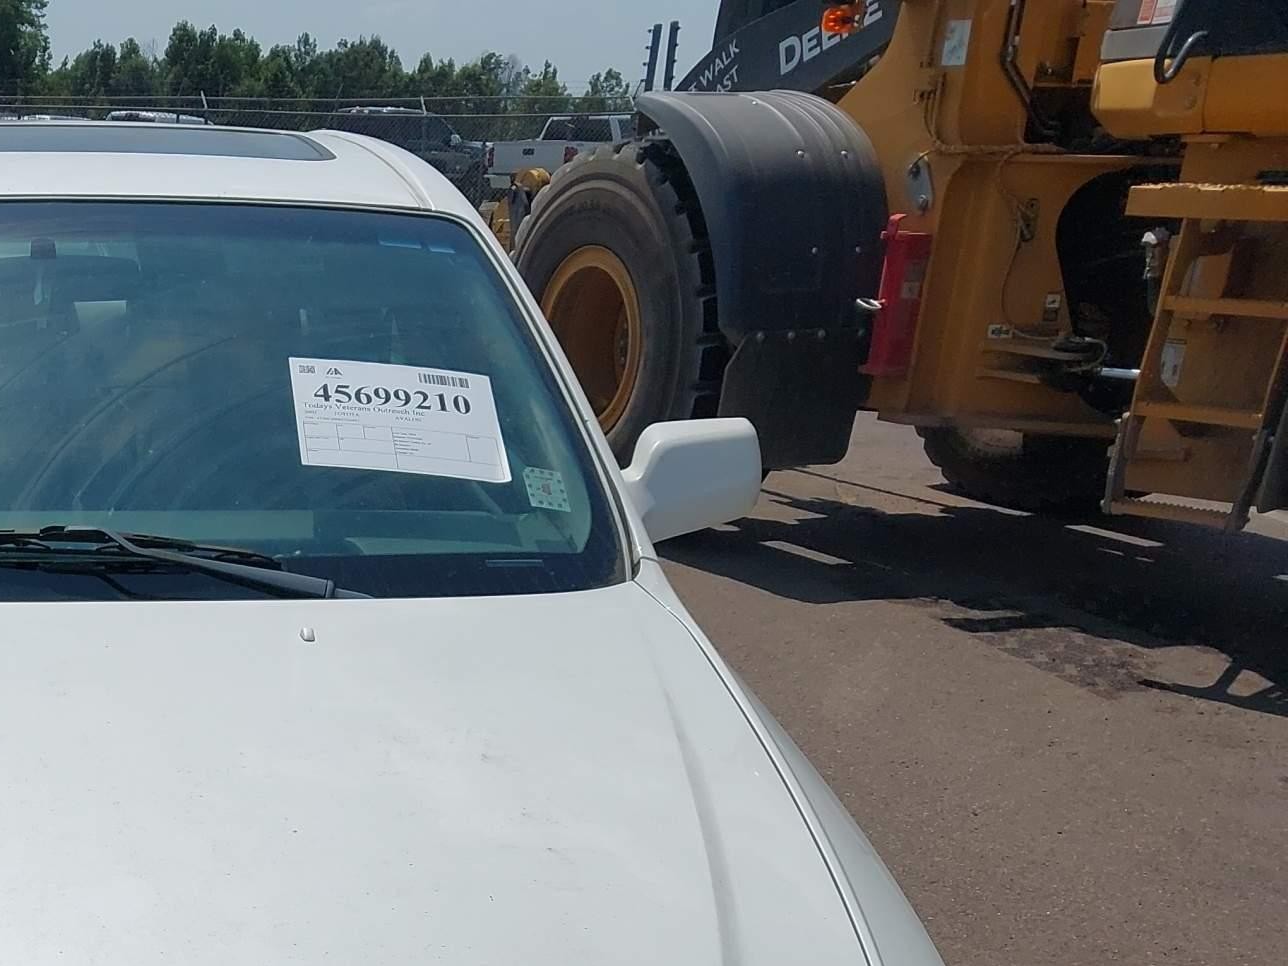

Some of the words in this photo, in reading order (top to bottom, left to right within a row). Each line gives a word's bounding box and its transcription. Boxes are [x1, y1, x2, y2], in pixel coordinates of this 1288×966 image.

[779, 0, 883, 76] DEEE
[700, 39, 740, 88] WALK
[304, 402, 332, 410] Todays
[335, 403, 371, 412] Veterans
[314, 383, 471, 415] 45699210
